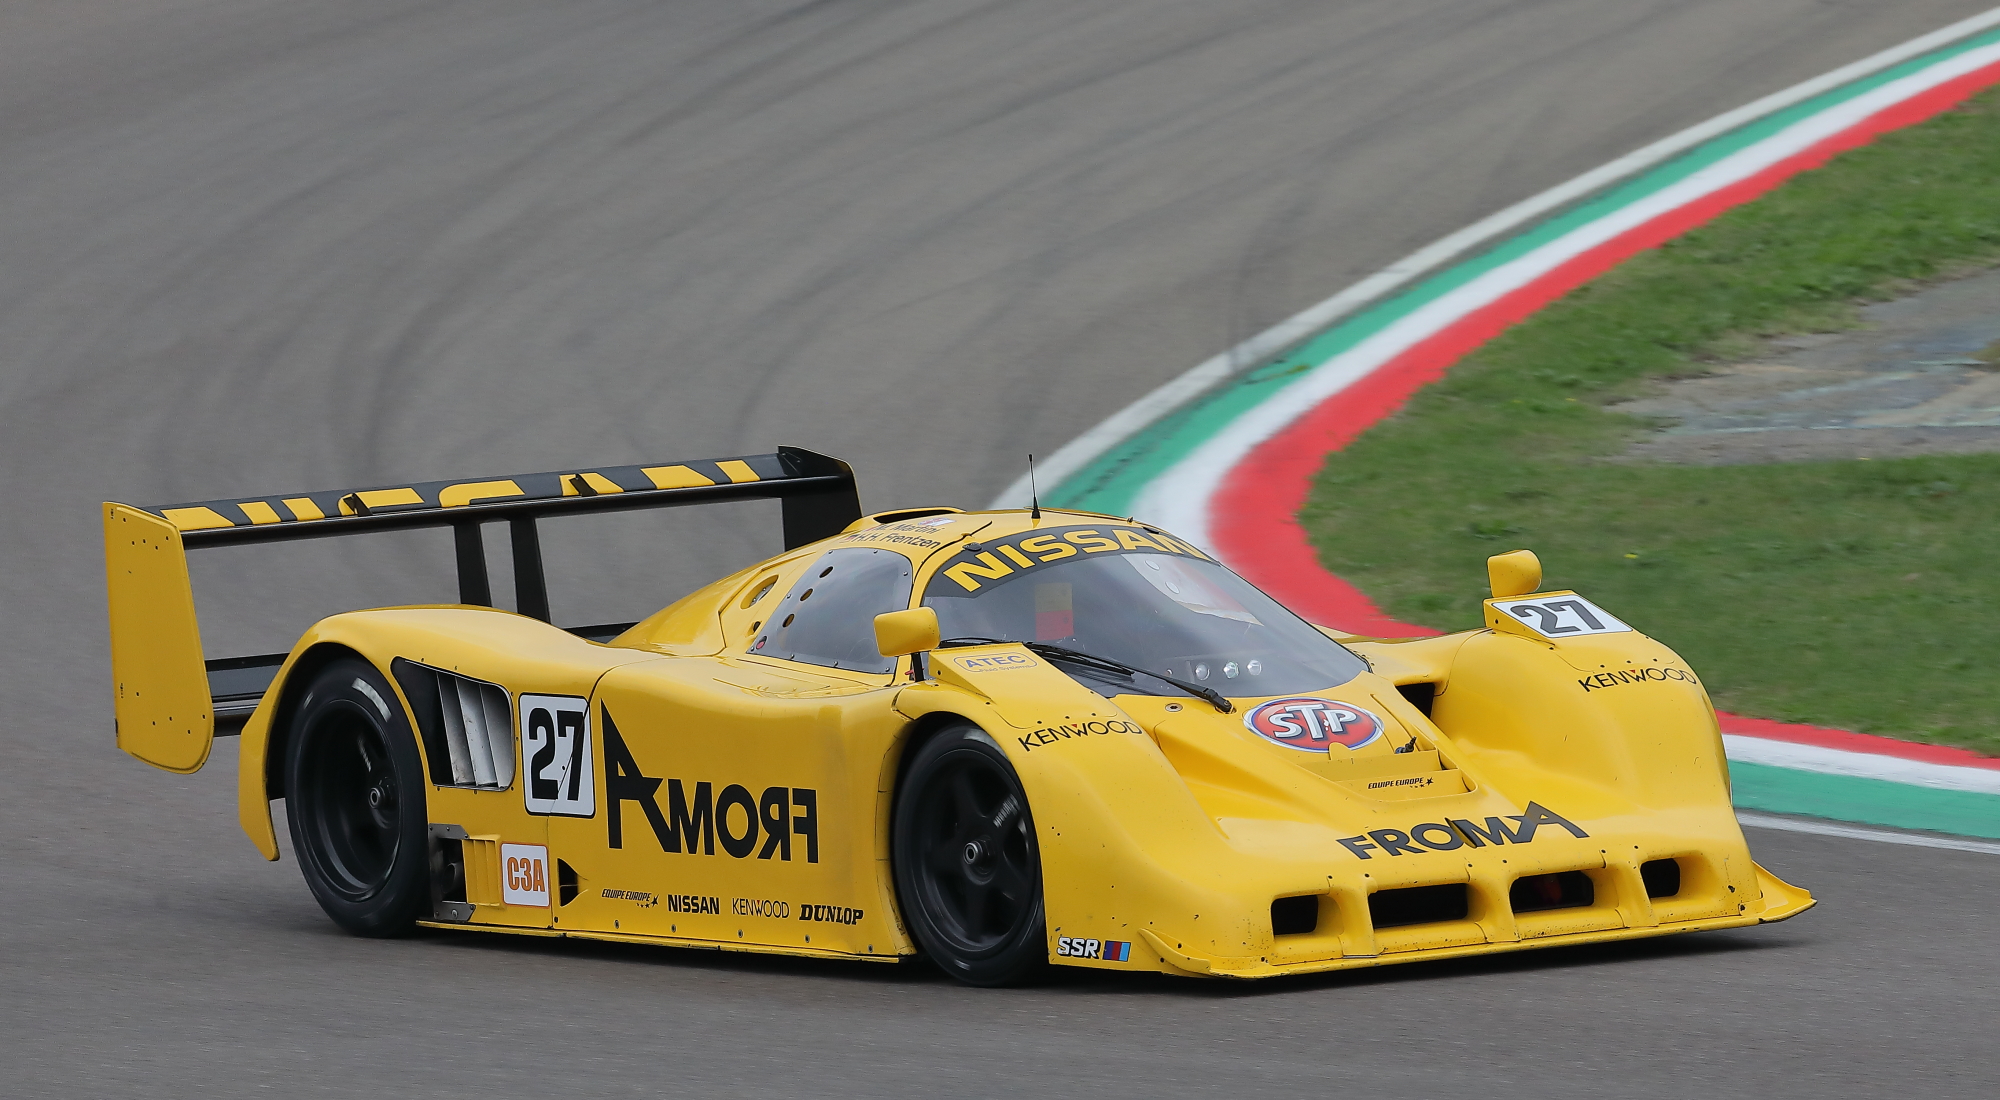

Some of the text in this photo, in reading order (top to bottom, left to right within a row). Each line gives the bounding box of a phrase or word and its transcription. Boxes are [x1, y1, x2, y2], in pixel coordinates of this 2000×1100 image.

[880, 533, 941, 549] Frentzen
[943, 529, 1211, 592] NISSAN
[1510, 600, 1606, 634] 27
[965, 655, 1026, 668] ATEC
[1578, 667, 1696, 692] KENWOOD
[1268, 703, 1359, 741] STP
[1017, 720, 1143, 751] KENWOOD
[528, 707, 583, 801] 27
[1368, 777, 1424, 790] EQUIPE EUROPE
[506, 856, 545, 892] C3A
[601, 888, 652, 902] EQUIPE EUROPE
[667, 894, 720, 915] NISSAN
[732, 898, 790, 918] KENWOOD
[799, 904, 864, 925] DUNLOP
[1057, 937, 1101, 959] SSR
